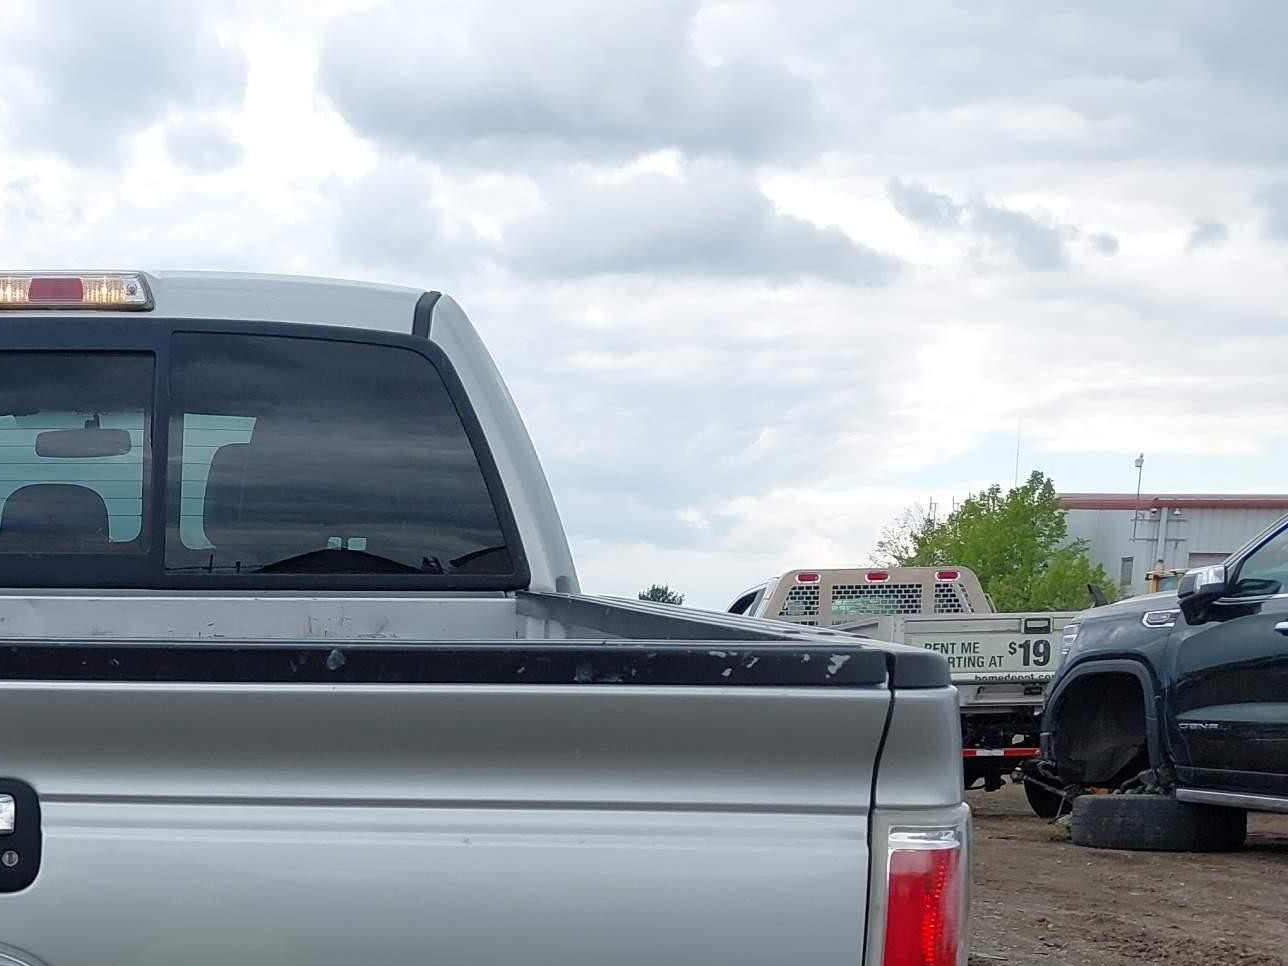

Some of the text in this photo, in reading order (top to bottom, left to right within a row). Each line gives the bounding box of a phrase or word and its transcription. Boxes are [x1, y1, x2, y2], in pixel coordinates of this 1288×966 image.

[960, 642, 980, 654] ME
[1008, 639, 1051, 667] $19
[947, 655, 1004, 668] RTING AT
